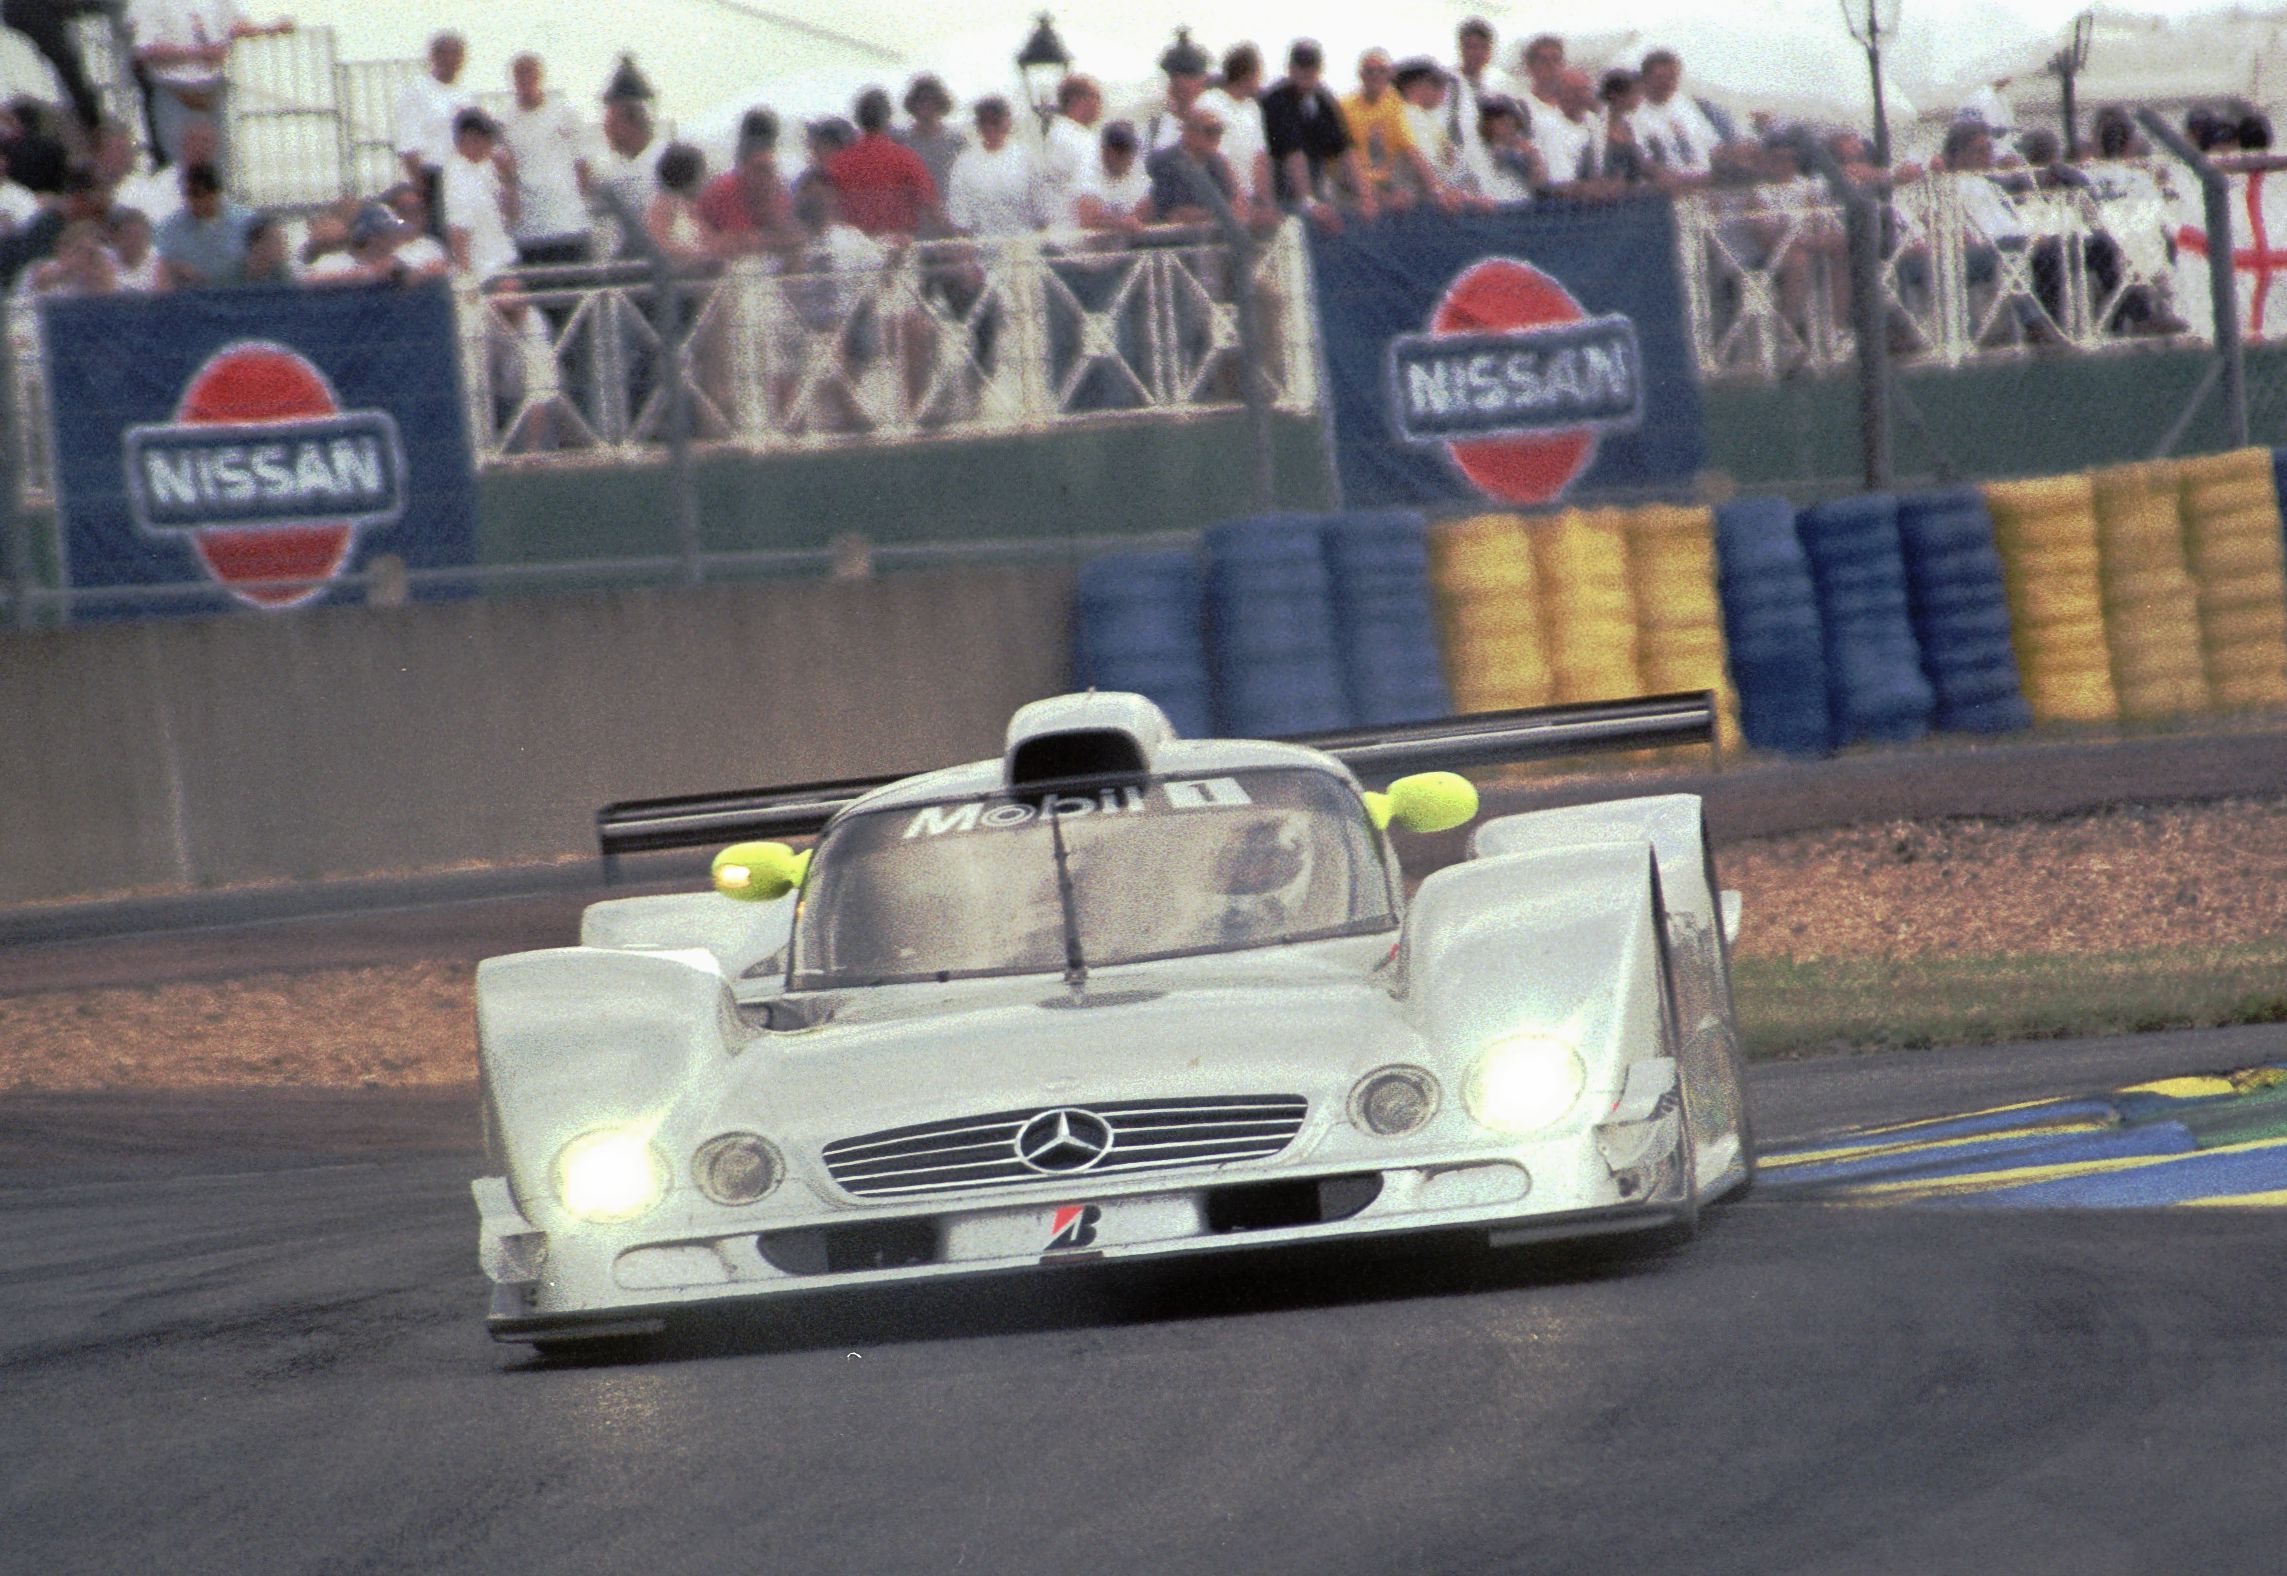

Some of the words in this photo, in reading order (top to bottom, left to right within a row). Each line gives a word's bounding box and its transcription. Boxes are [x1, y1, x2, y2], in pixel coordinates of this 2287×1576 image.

[1408, 342, 1626, 414] NISSAN
[147, 437, 379, 504] NISSAN
[903, 786, 1146, 840] Mobil
